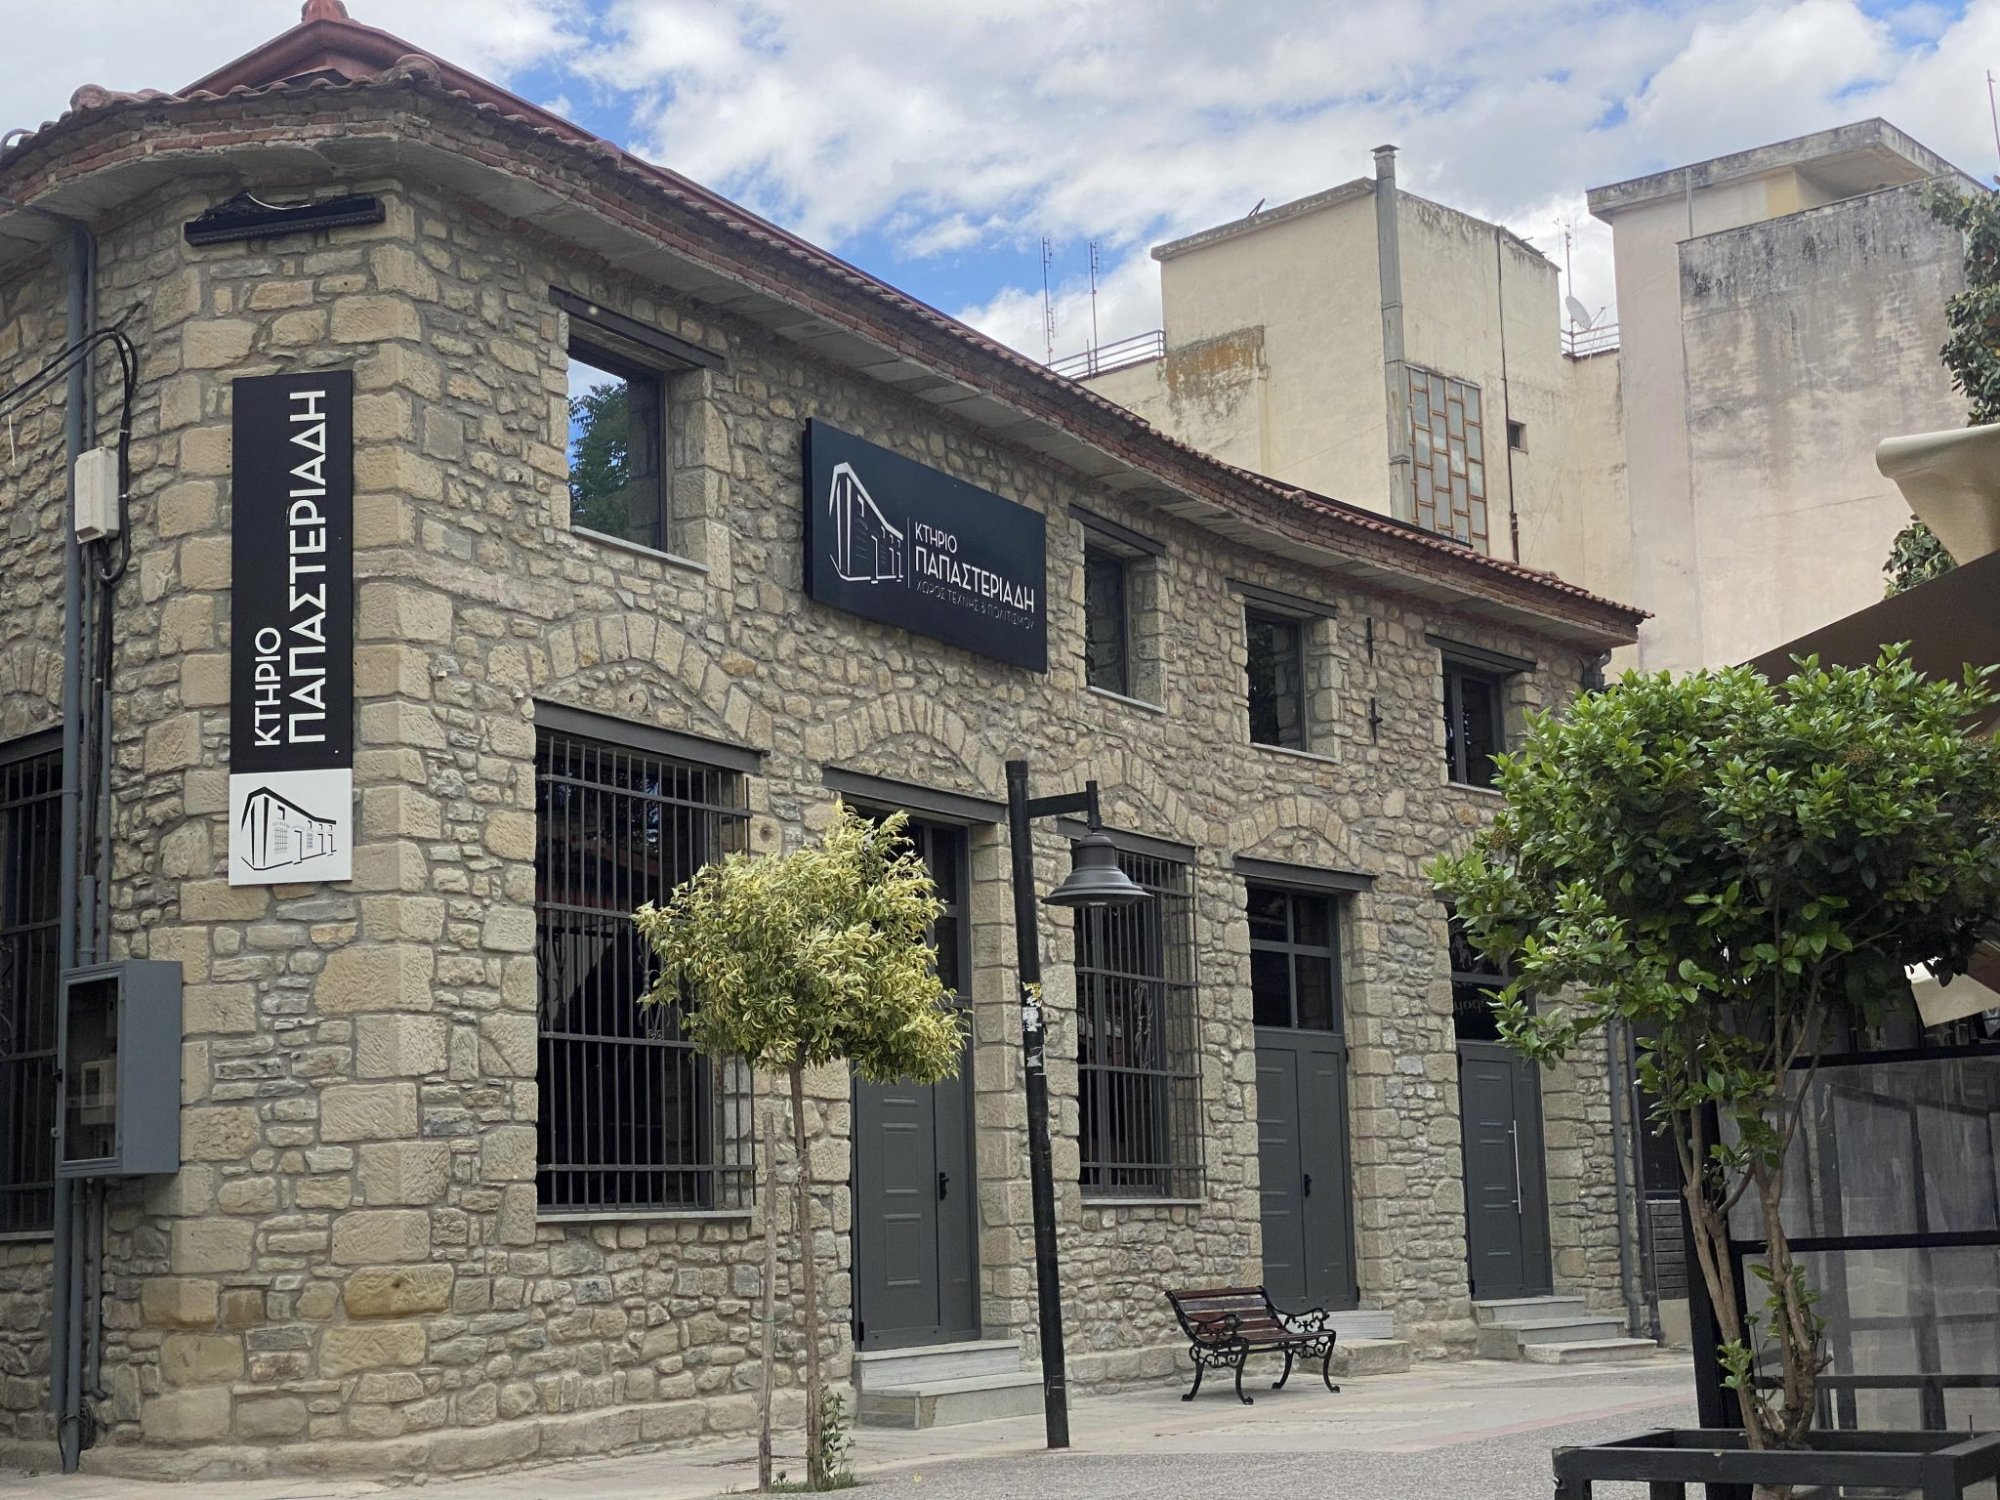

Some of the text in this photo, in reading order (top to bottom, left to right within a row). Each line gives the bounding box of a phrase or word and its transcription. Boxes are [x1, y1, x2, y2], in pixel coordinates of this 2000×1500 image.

[288, 390, 326, 744] ΠΑΠΑΣΤΕΡΙΑΔΗ
[915, 521, 958, 554] ΚΤΗΡΙΟ
[915, 545, 1034, 613] ΠΑΠΑΣΤΕΡΙΑΔΗ
[916, 580, 945, 600] ΧΩΡΟΣ
[947, 589, 979, 612] ΤΕΧΝΗΣ
[254, 627, 281, 747] ΚΤΗΡΙΟ
